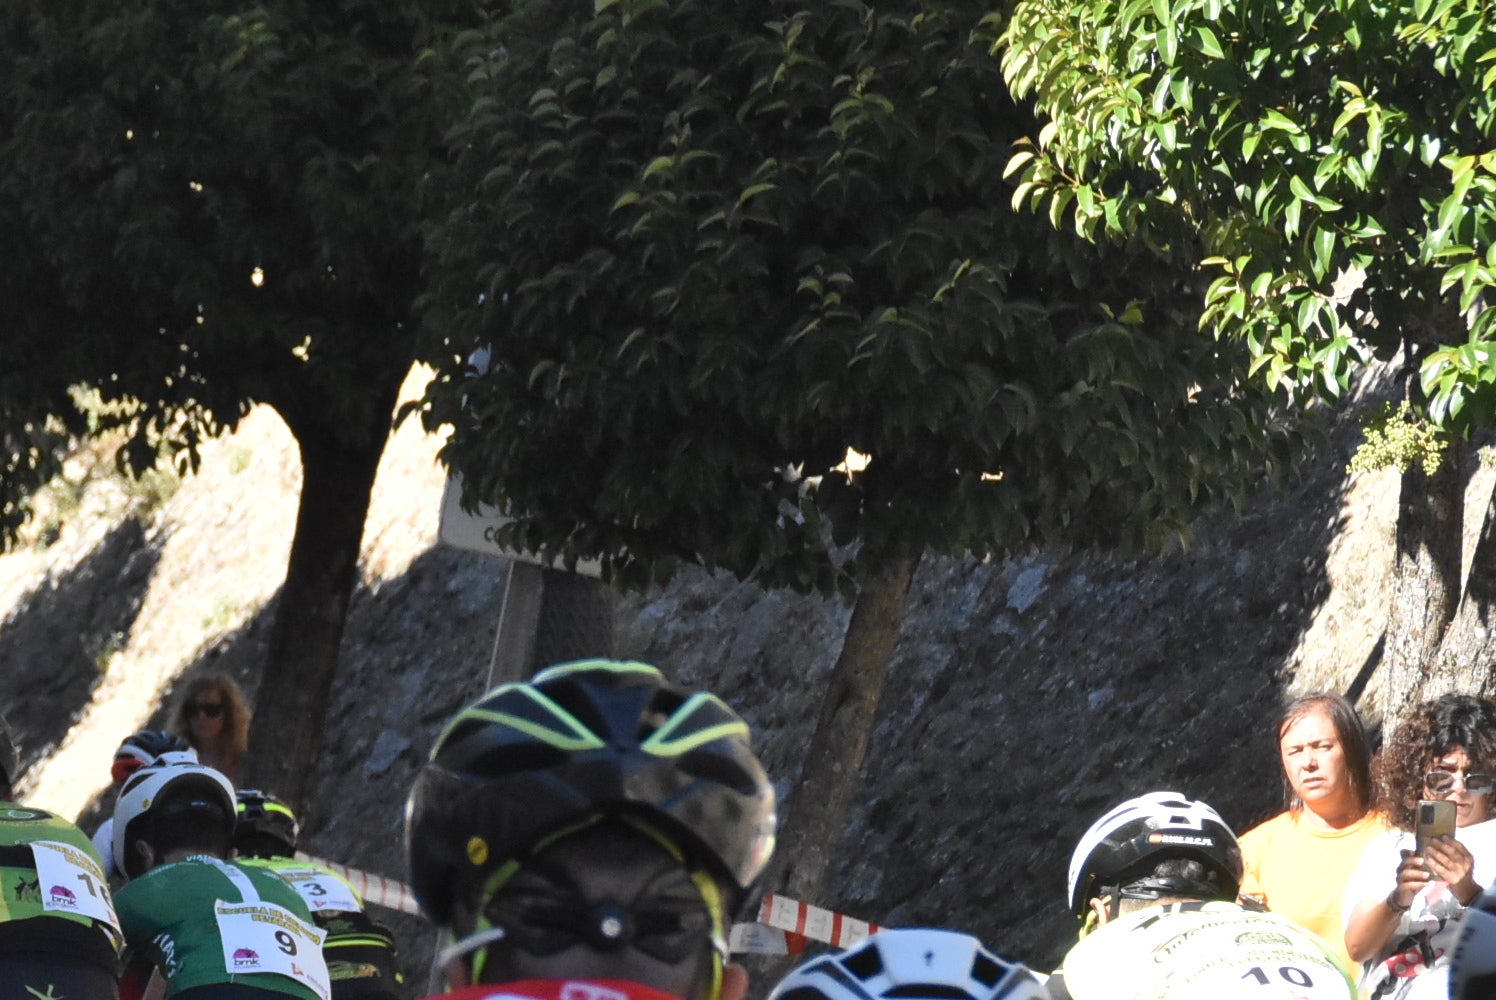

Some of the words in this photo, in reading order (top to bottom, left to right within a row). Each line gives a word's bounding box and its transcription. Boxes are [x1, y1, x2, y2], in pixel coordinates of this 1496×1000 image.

[303, 882, 327, 896] 3
[274, 930, 297, 956] 9
[1240, 966, 1314, 988] 10
